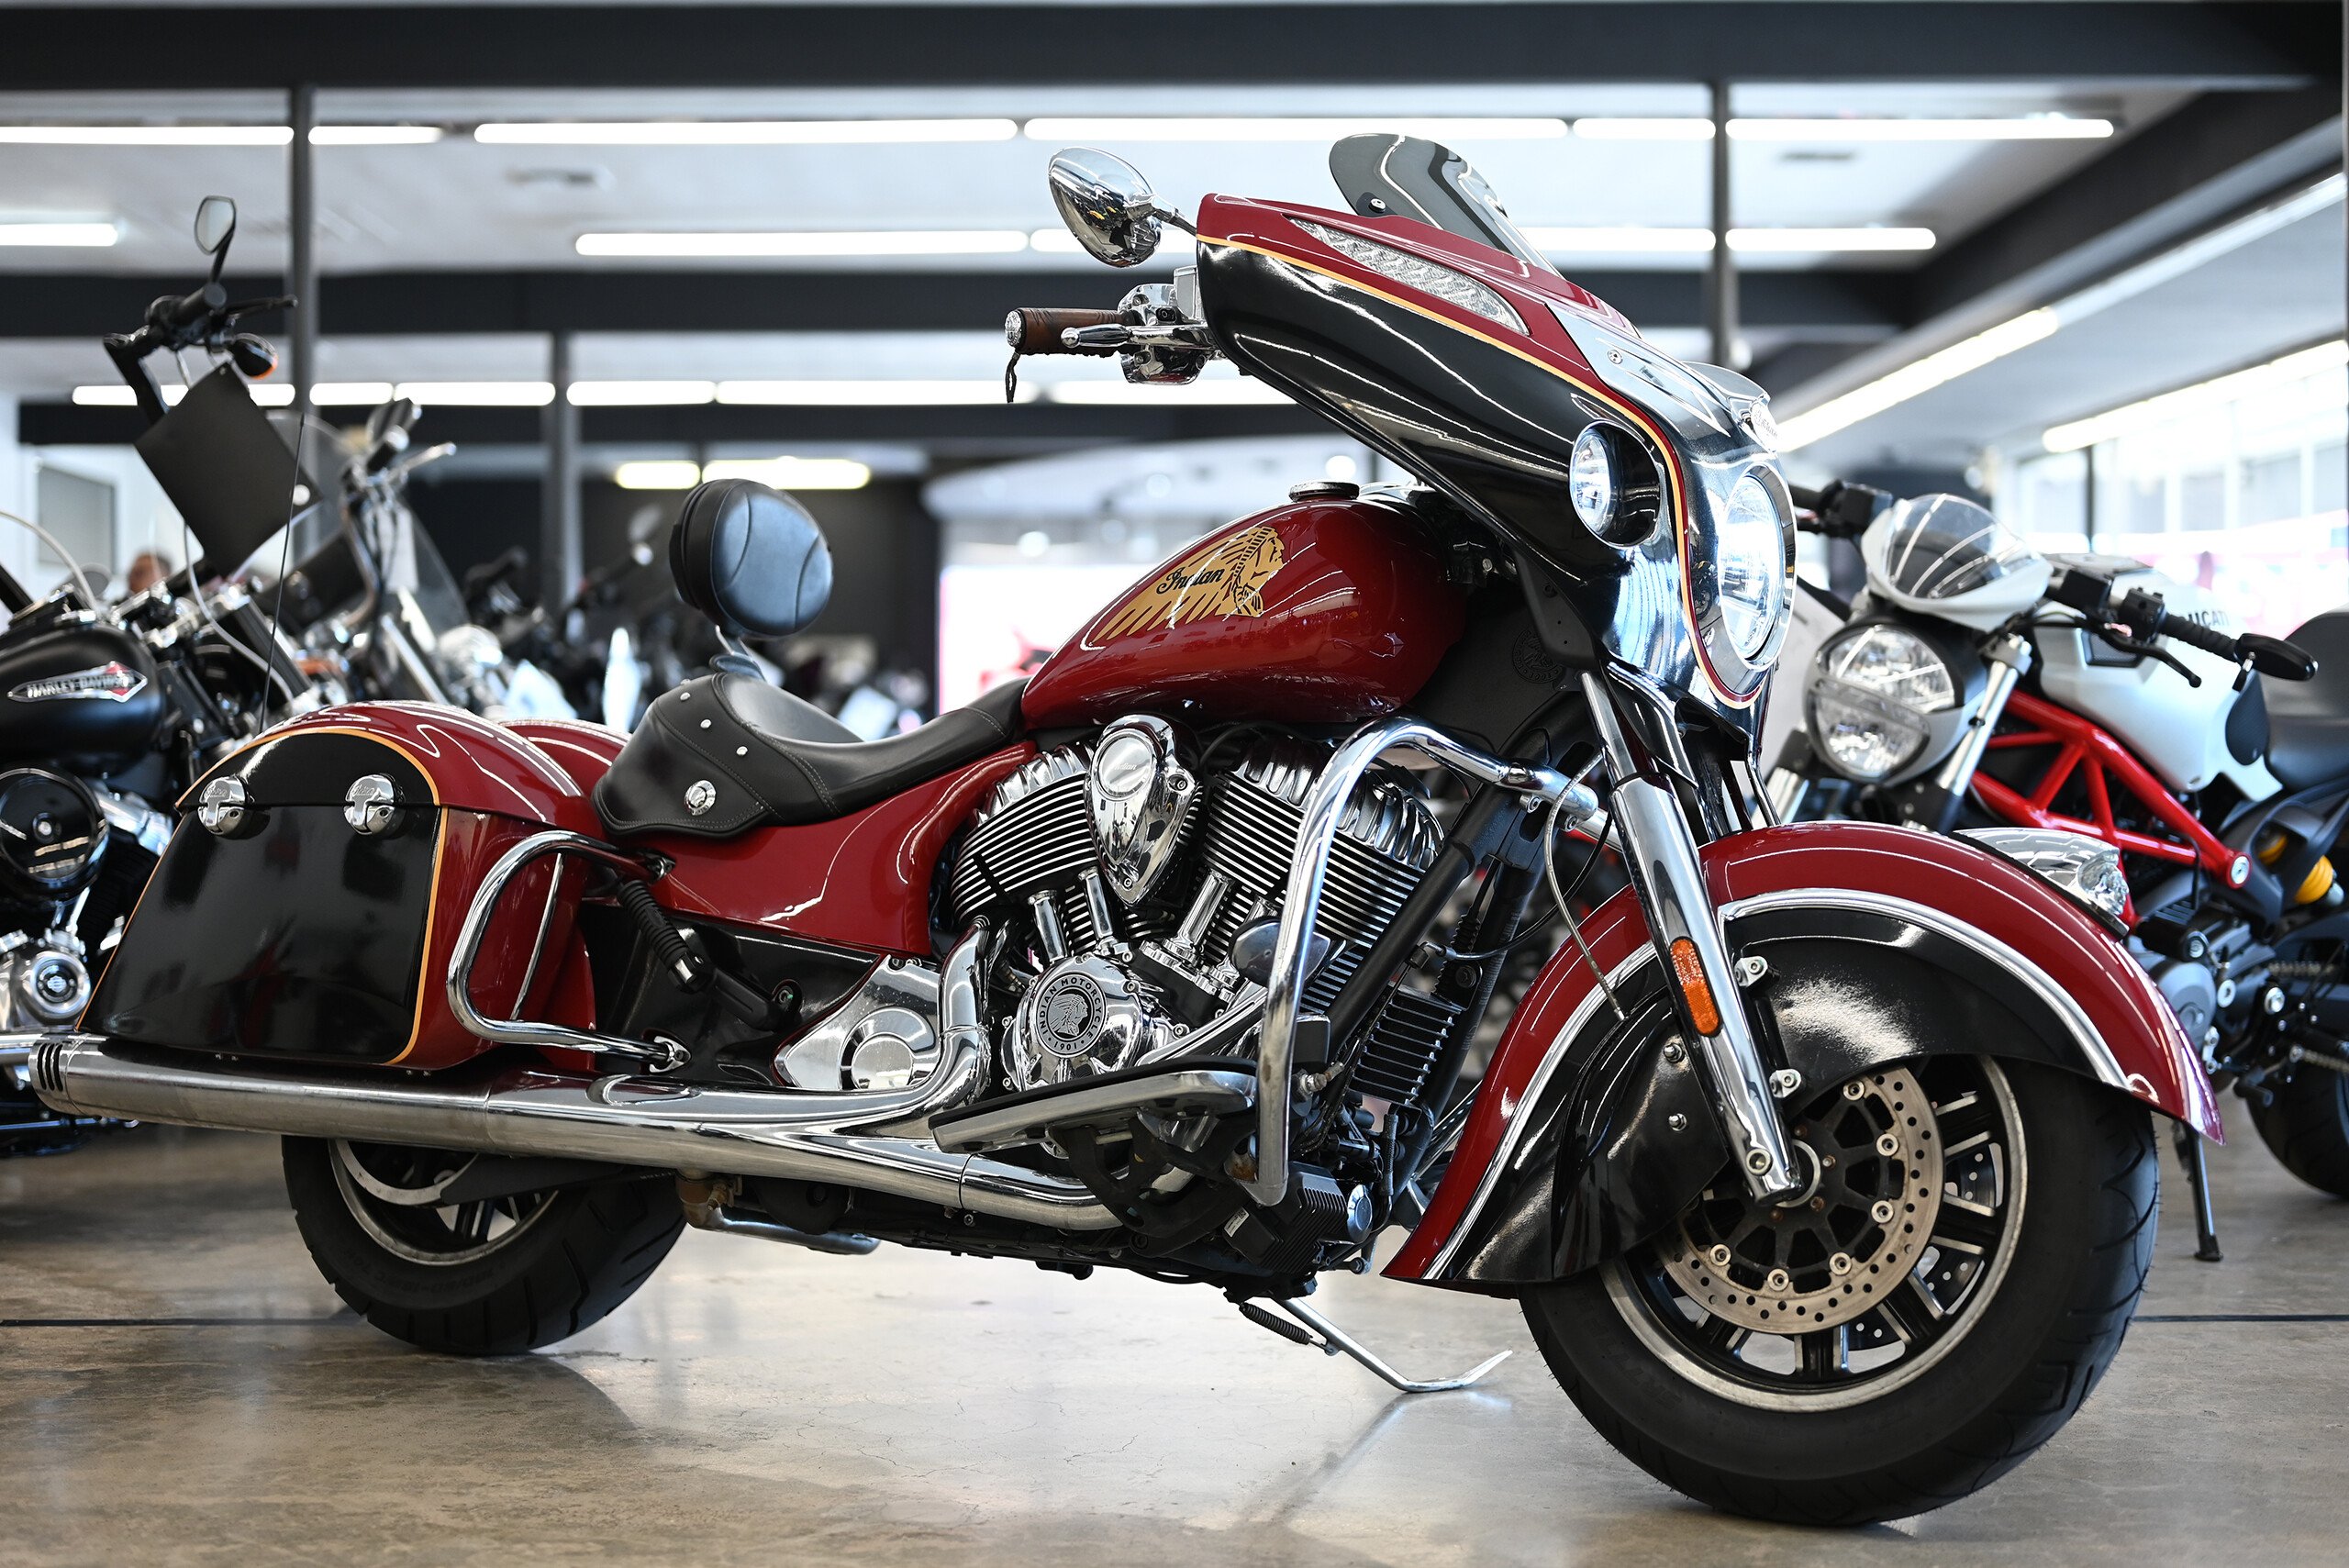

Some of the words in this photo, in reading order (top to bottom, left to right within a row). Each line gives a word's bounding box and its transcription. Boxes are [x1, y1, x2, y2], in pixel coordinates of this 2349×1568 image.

[1156, 566, 1225, 595] Indian
[2188, 610, 2230, 628] UCATI
[1040, 985, 1057, 1035] INDIAN
[1061, 977, 1102, 1039] MOTORCYCLE
[1053, 1041, 1077, 1051] 1901
